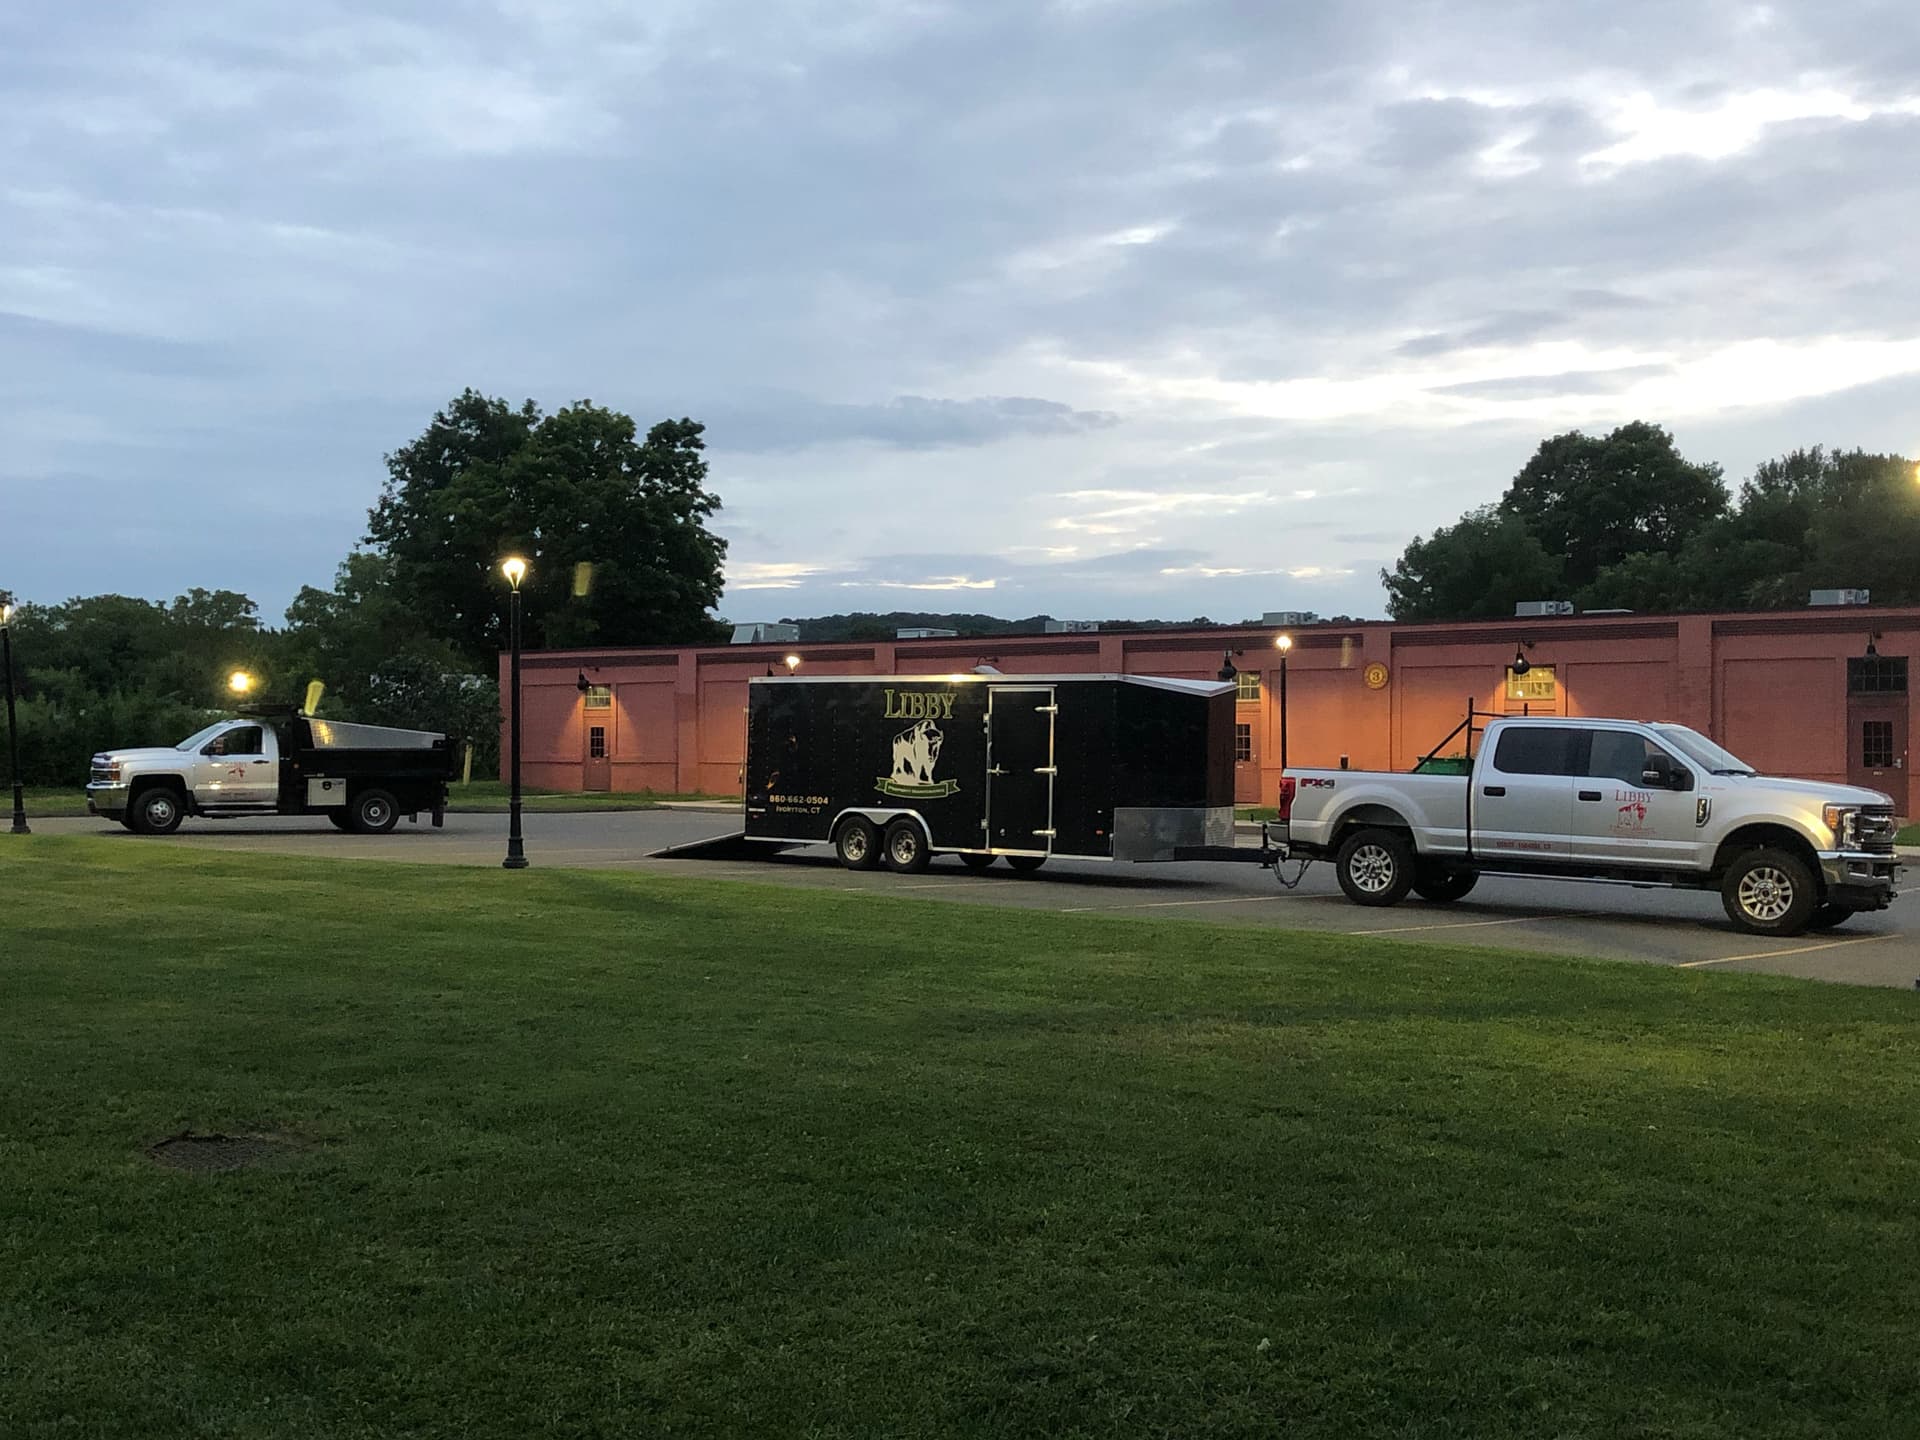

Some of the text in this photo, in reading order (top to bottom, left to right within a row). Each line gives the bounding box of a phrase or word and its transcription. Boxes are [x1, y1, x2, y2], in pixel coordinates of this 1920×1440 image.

[884, 689, 957, 719] LIBBY
[1301, 778, 1335, 789] FX4
[1616, 789, 1654, 802] LIBBY
